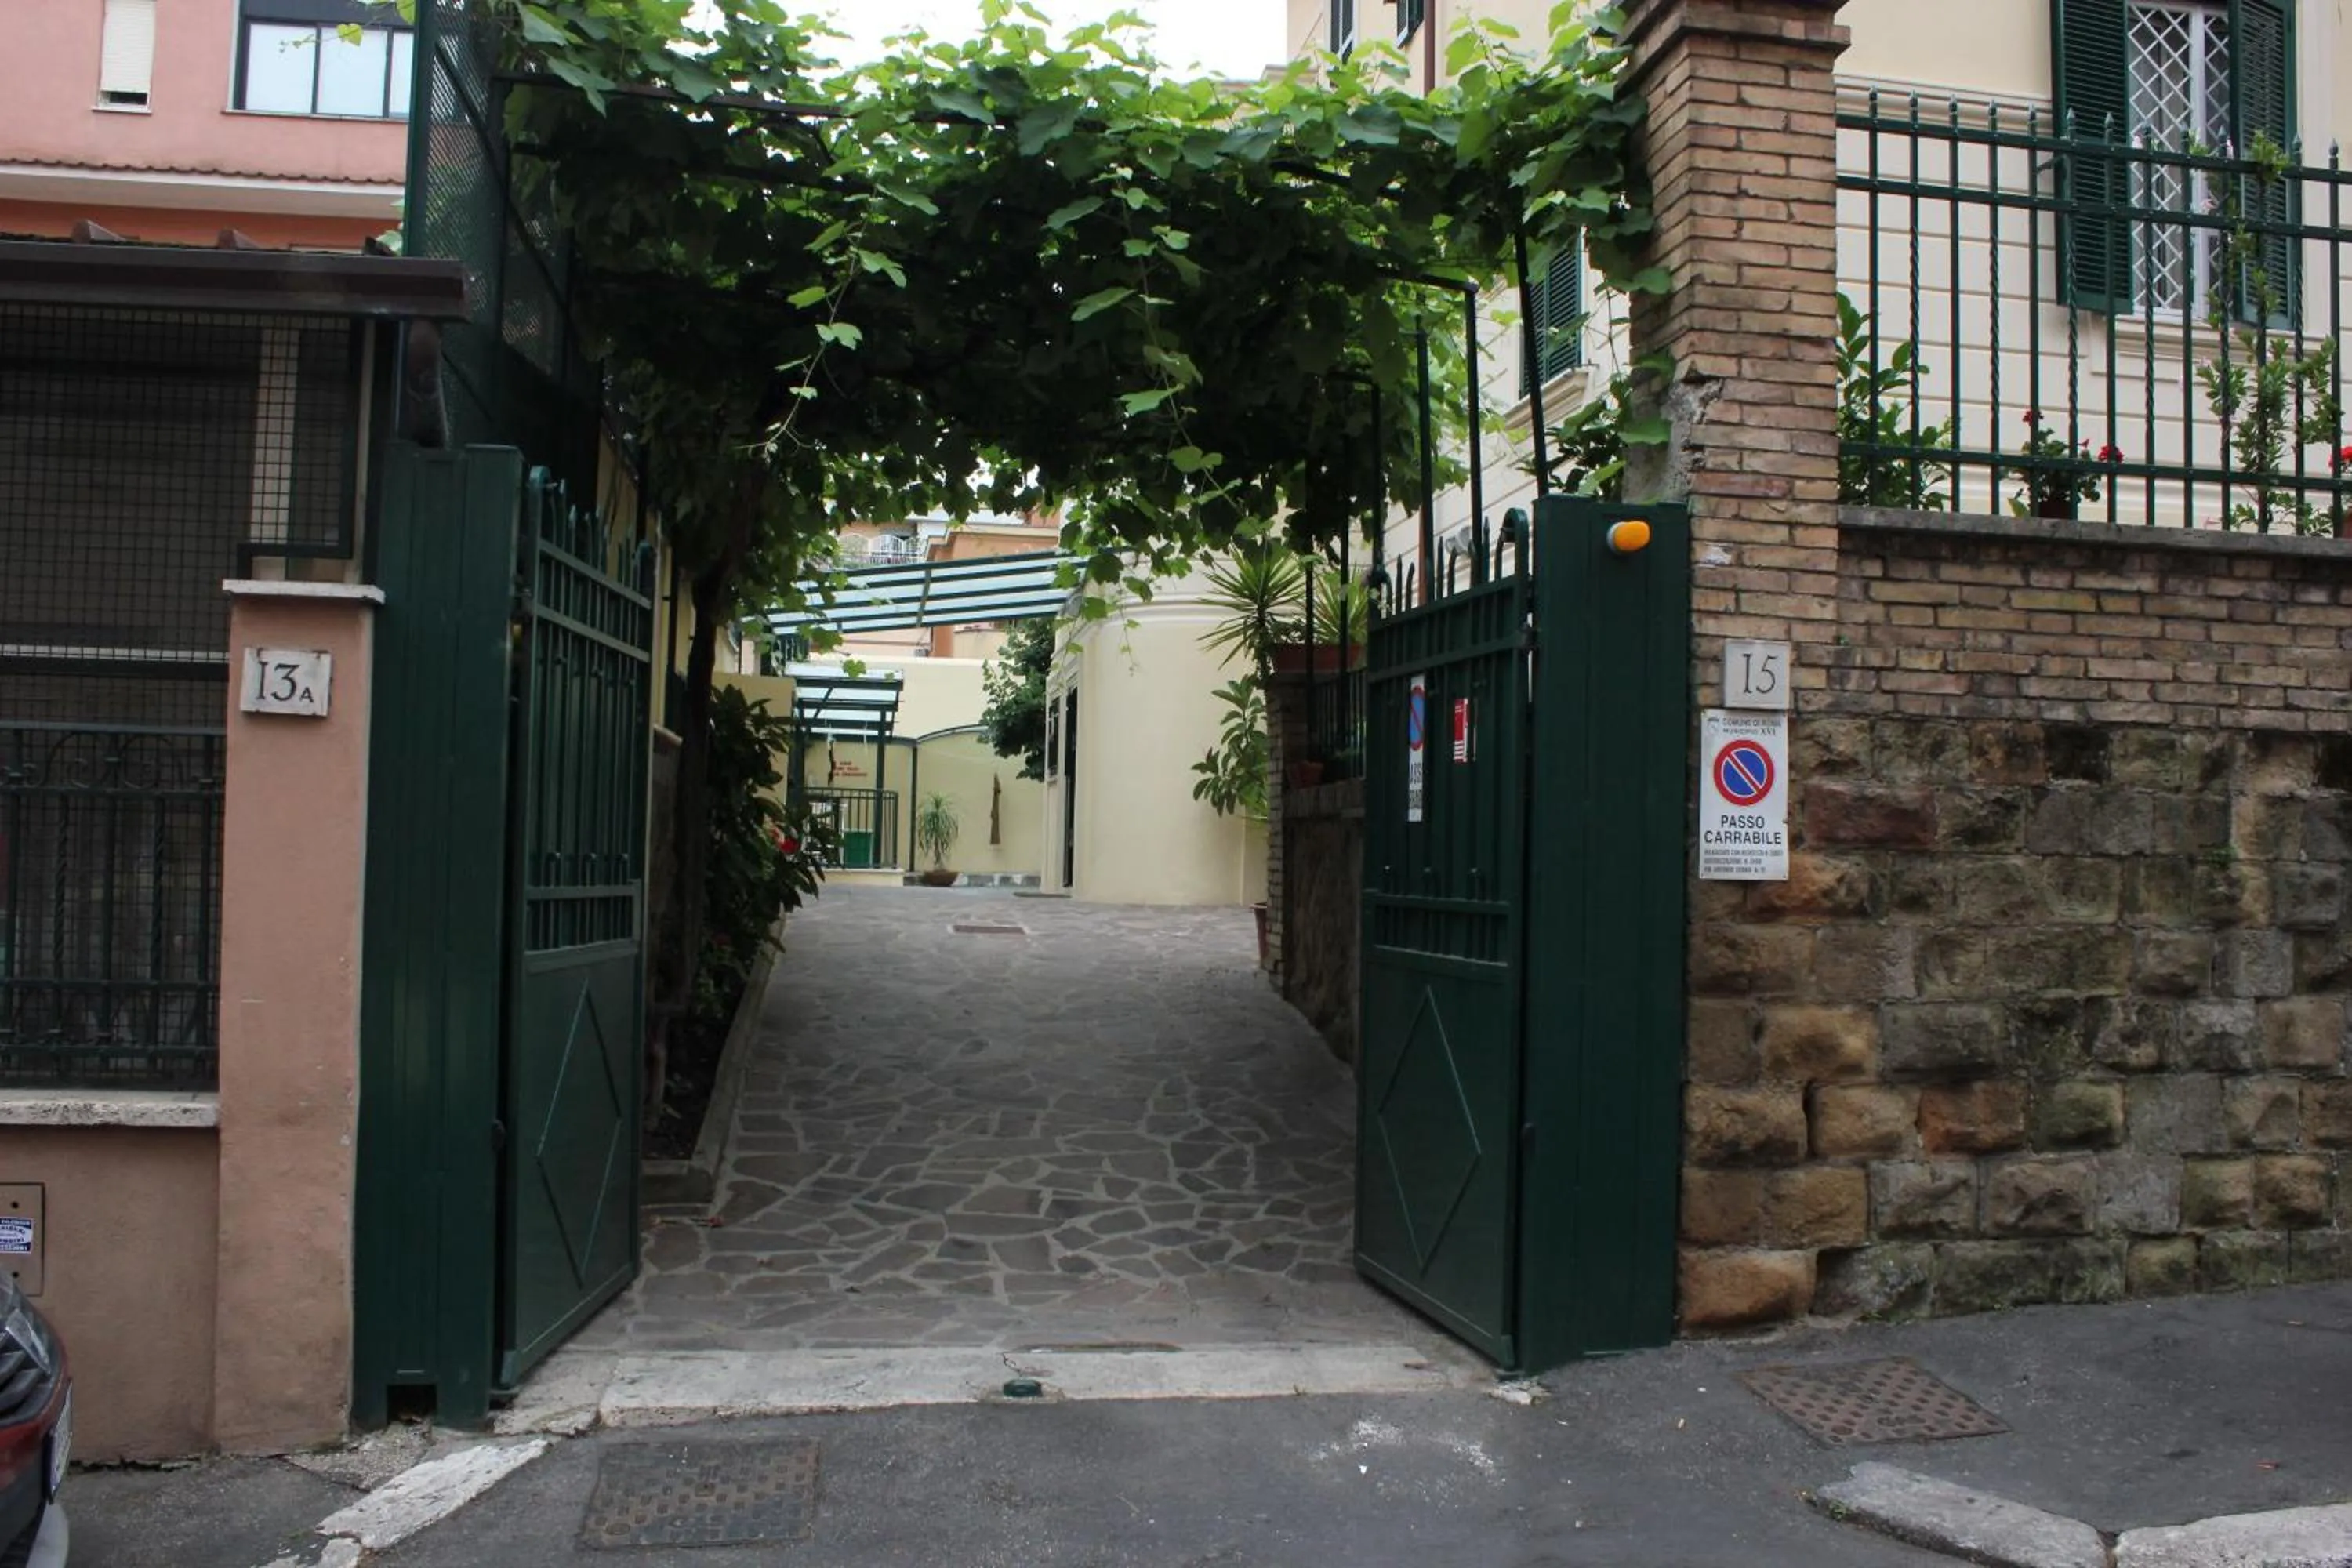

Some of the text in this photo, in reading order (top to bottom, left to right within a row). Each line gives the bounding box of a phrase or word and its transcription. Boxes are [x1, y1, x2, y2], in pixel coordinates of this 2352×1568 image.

[1743, 653, 1778, 695] 15
[1721, 815, 1765, 829] PASSO
[1704, 830, 1782, 844] CARRABILE
